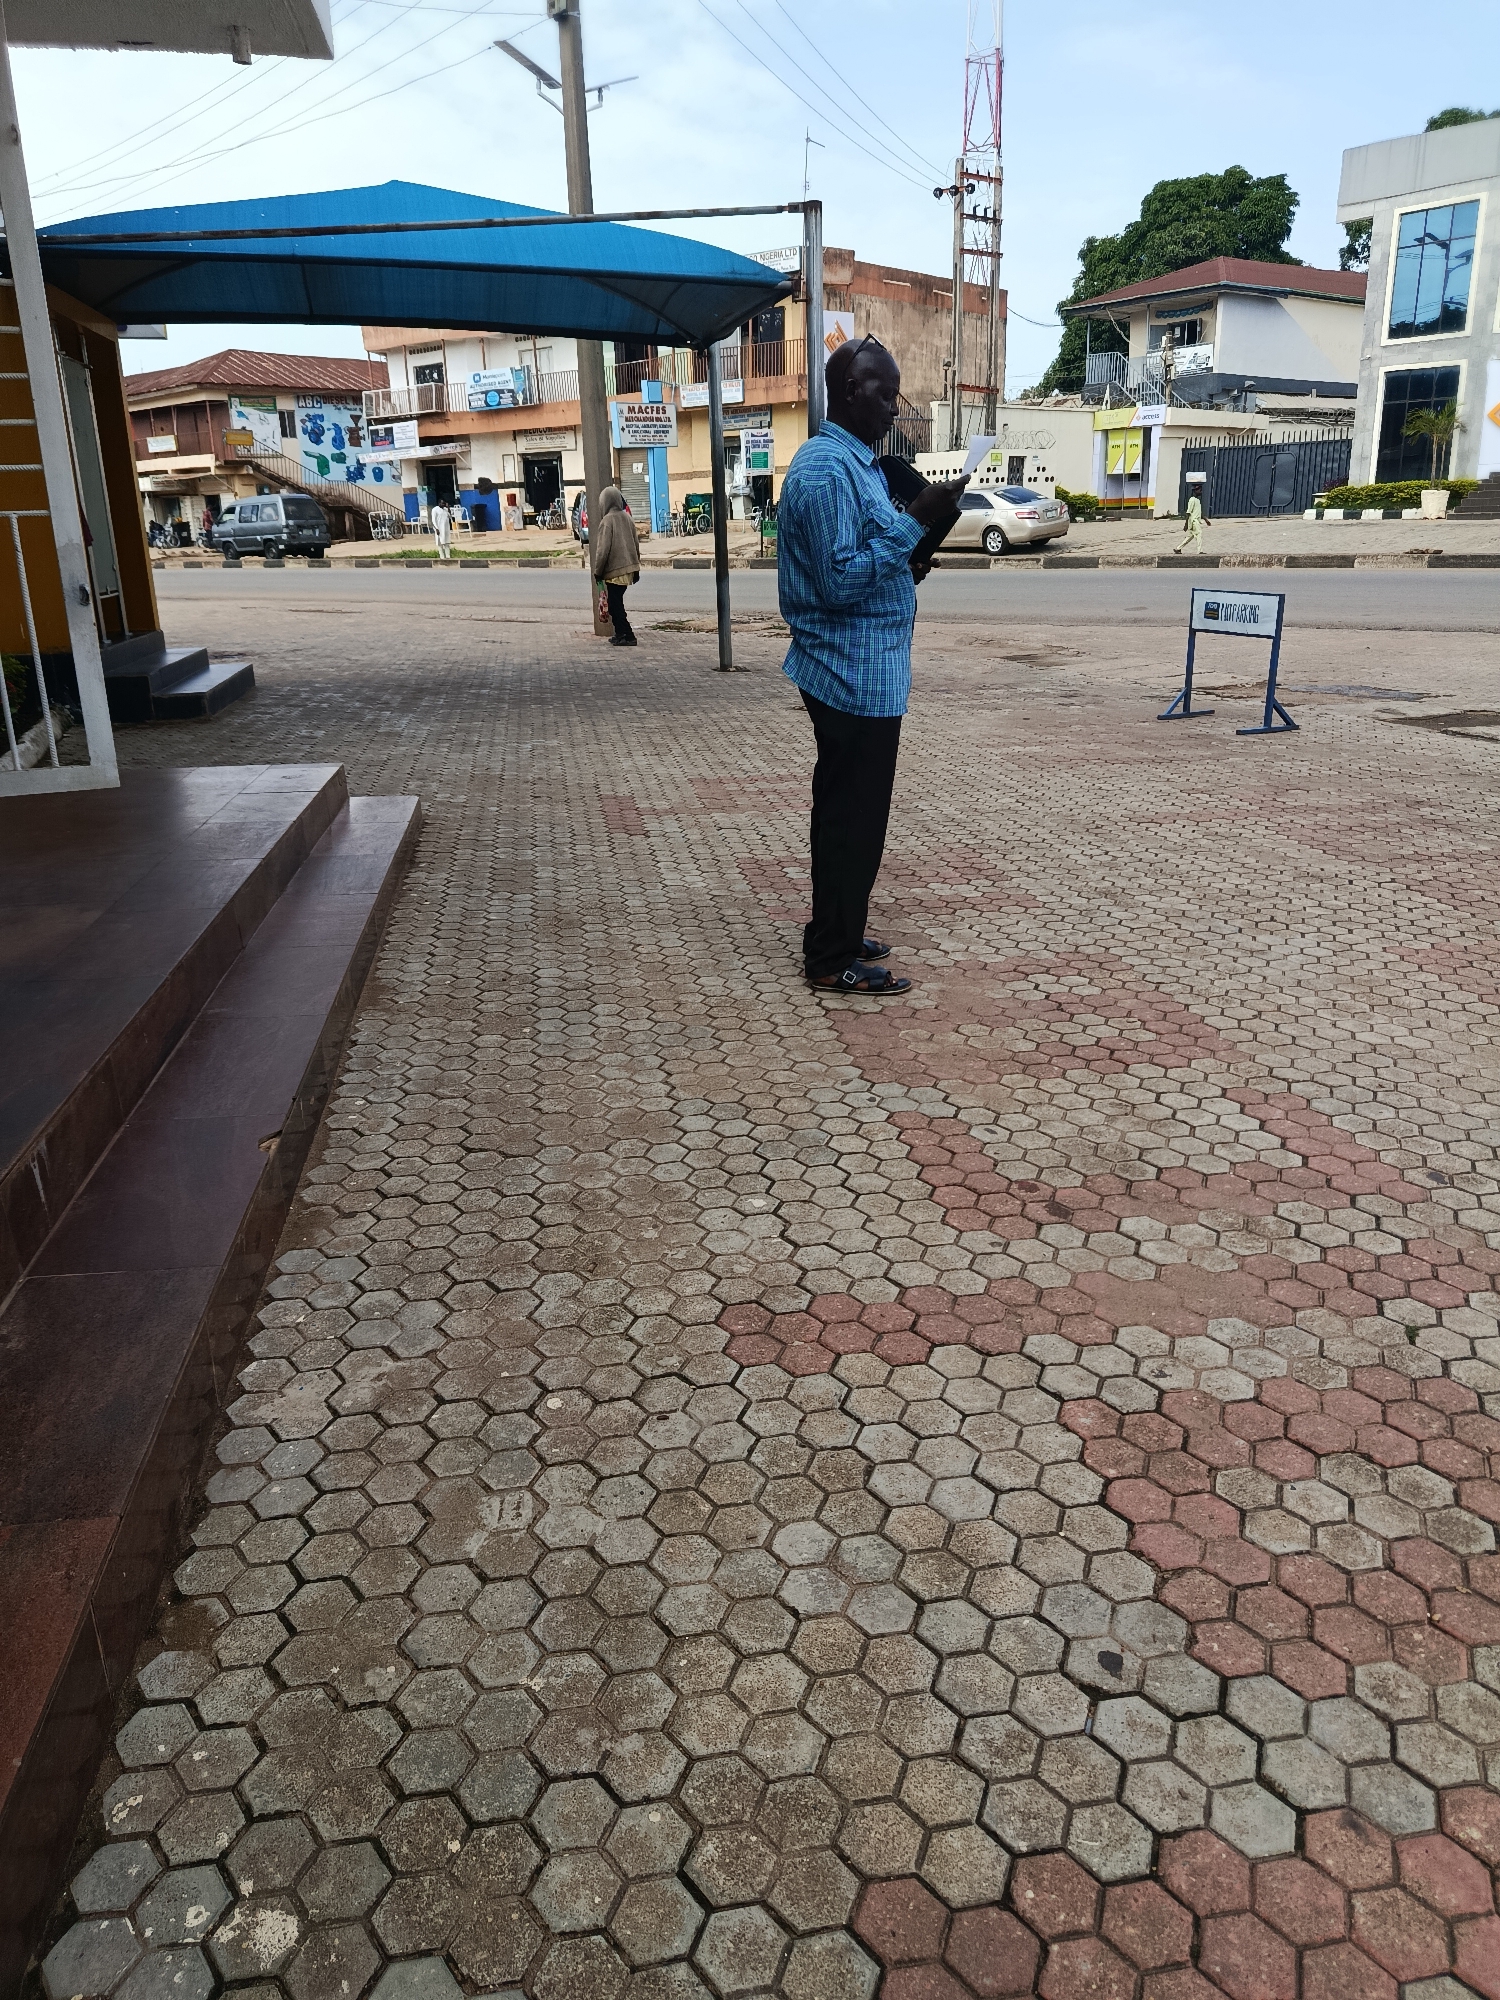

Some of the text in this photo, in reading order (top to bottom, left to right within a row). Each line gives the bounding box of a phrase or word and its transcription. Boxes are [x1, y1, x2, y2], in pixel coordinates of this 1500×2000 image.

[760, 251, 784, 261] NIGERIA
[785, 248, 797, 257] LTD
[299, 395, 321, 408] ABC
[322, 395, 349, 404] DIESEL
[627, 405, 667, 414] MACFES
